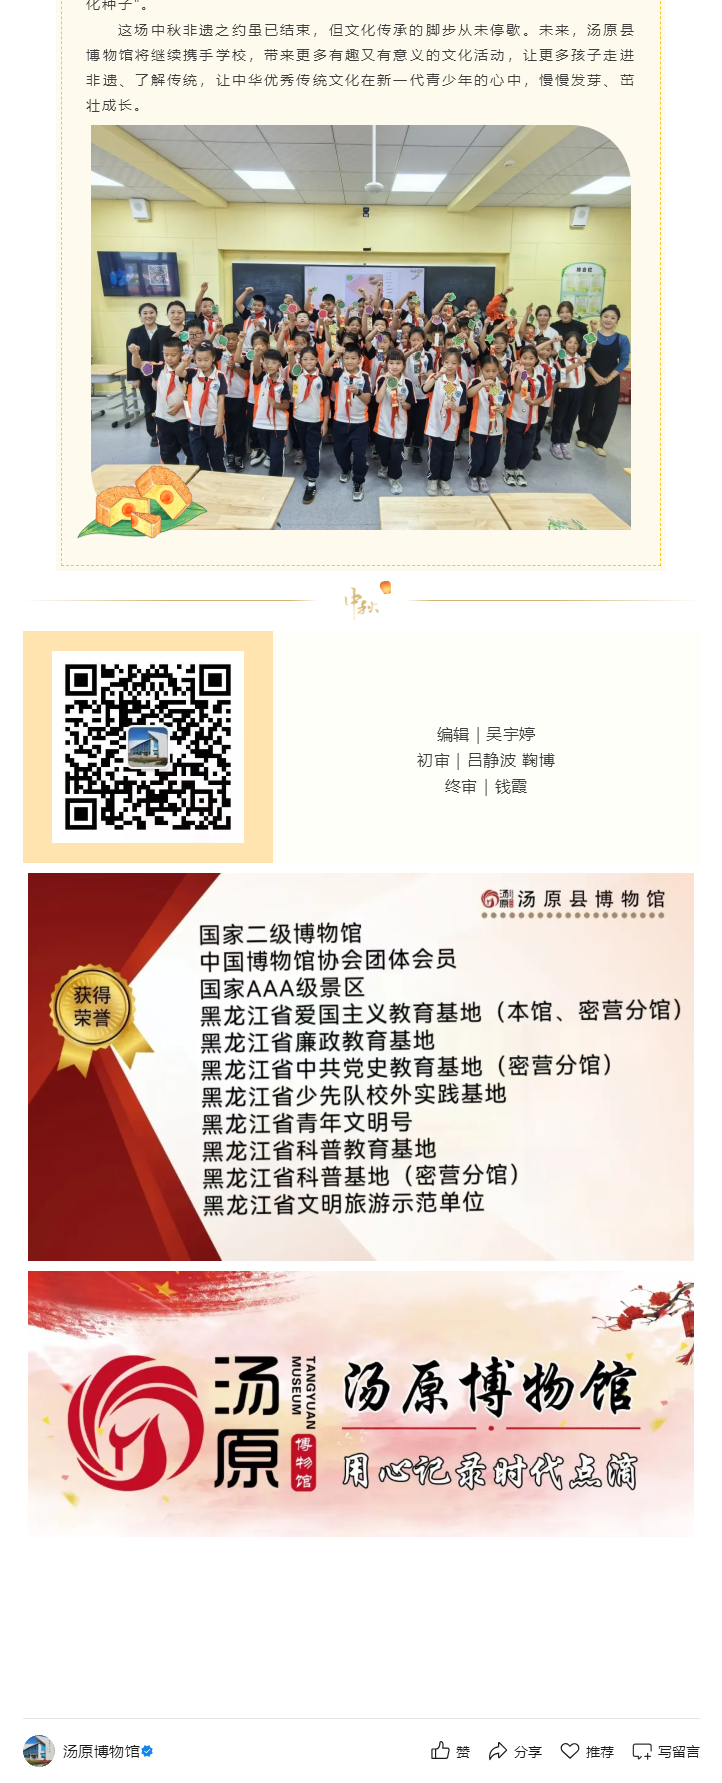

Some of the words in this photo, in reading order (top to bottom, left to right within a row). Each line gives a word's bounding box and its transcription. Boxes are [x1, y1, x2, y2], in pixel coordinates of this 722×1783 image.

[117, 23, 635, 38] 这场中秋非遗之约虽已结束，但文化传承的脚步从未停歇。未来，汤原县
[86, 48, 635, 63] 博物馆将继续携手学校，带来更多有趣又有意义的文化活动，让更多孩子走进
[86, 72, 635, 88] 非遗、了解传统，让中华优秀传统文化在新一代青少年的心中，慢慢发芽、茁
[86, 98, 140, 113] 壮成长。
[344, 587, 379, 620] 中秋
[518, 890, 664, 908] 汤原县博物馆
[200, 922, 361, 945] 国家二级博物馆
[201, 948, 456, 972] 中国博物馆协会团体会员
[74, 986, 111, 1004] 获得
[201, 977, 364, 999] 国家AAA级景区
[74, 1009, 111, 1027] 荣誉
[201, 1030, 434, 1053] 黑龙江省廉政教育基地
[202, 1083, 506, 1108] 黑龙江省少先队校外实践基地
[202, 1112, 412, 1135] 黑龙江省青年文明号
[203, 1138, 436, 1162] 黑龙江省科普教育基地
[204, 1191, 484, 1216] 黑龙江省文明旅游示范单位
[291, 1356, 301, 1415] MUSEUM
[306, 1356, 316, 1430] TANGYUAN
[342, 1358, 638, 1418] 汤原博物馆
[214, 1356, 279, 1488] 汤原
[294, 1437, 313, 1489] 博物馆
[342, 1452, 637, 1491] 用心记录时代点滴
[63, 1744, 140, 1759] 汤原博物馆
[456, 1745, 470, 1759] 赞
[514, 1745, 543, 1759] 分享
[586, 1745, 615, 1759] 推荐
[658, 1745, 701, 1759] 写留言
